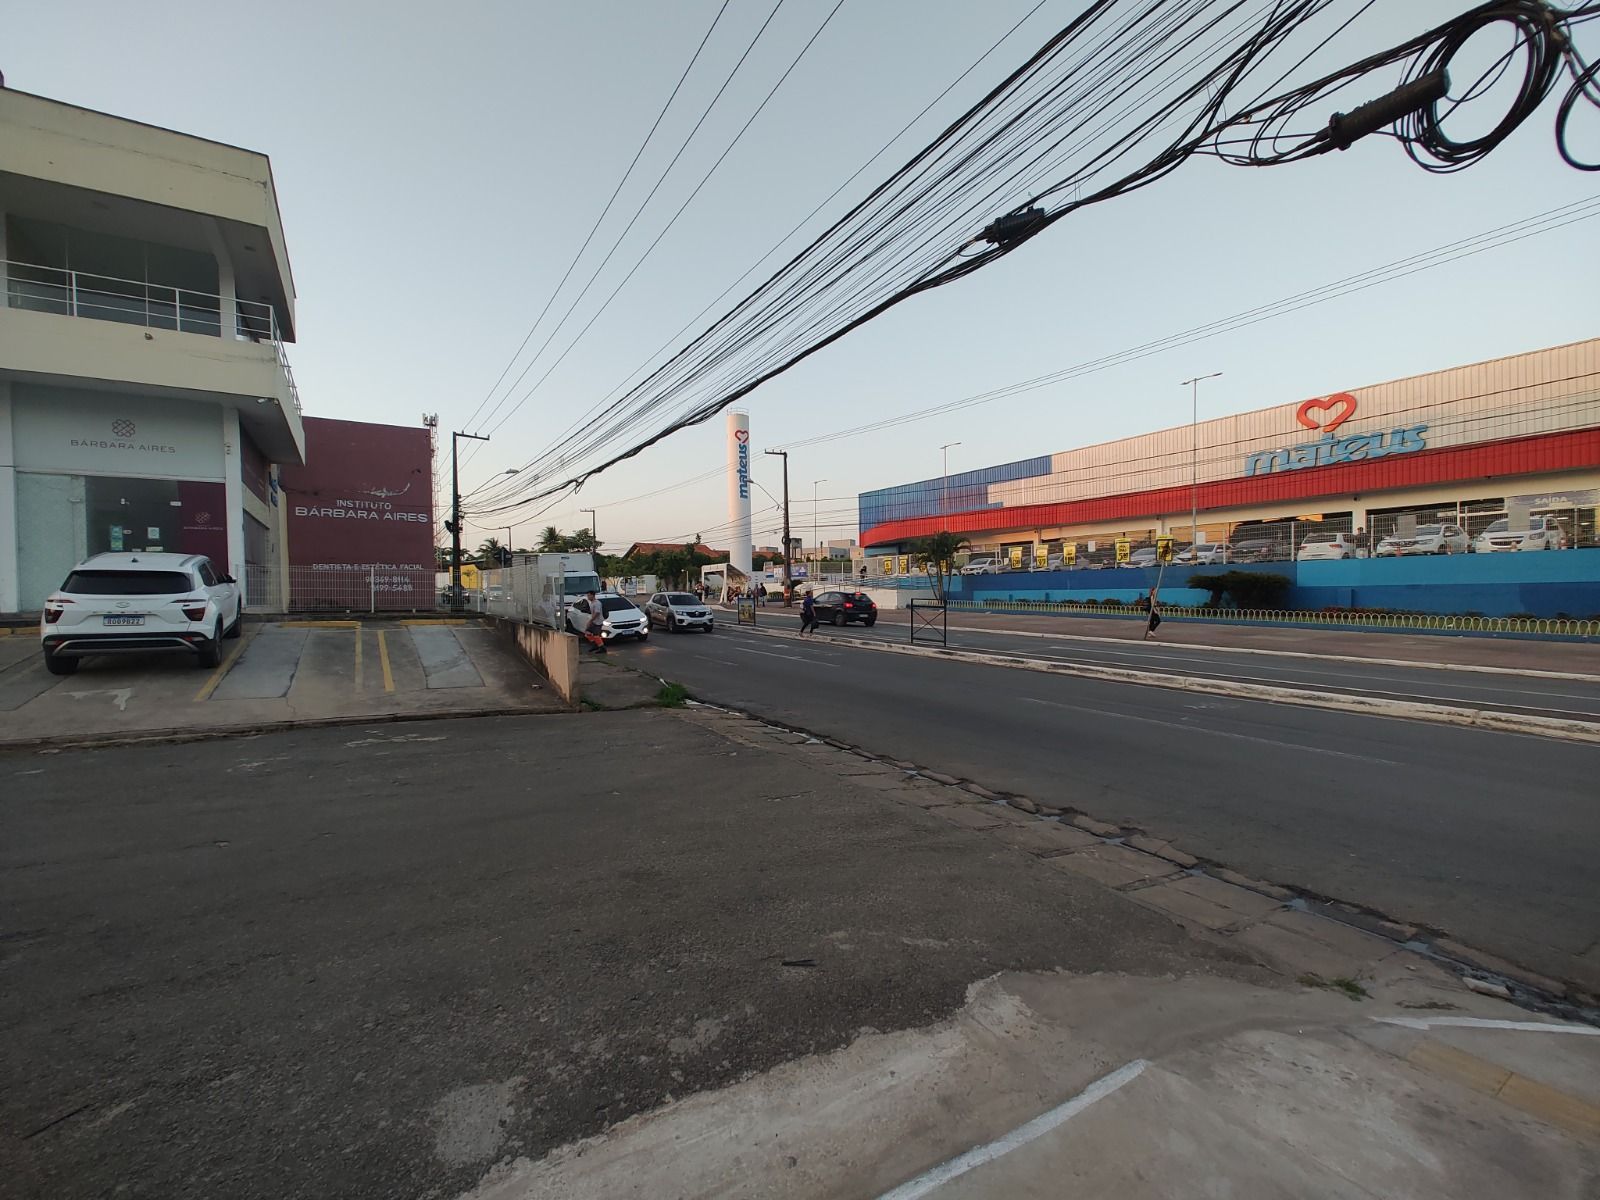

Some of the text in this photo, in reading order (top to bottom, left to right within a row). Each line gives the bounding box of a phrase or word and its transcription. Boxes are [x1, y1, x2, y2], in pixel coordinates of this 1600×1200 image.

[70, 438, 176, 454] BÁRBARA AIRES
[1244, 424, 1429, 477] mateus
[736, 443, 748, 500] mateus
[336, 499, 392, 511] INSTITUTO
[295, 505, 428, 523] BÁRBARA AIRES
[399, 563, 424, 571] FACIAL
